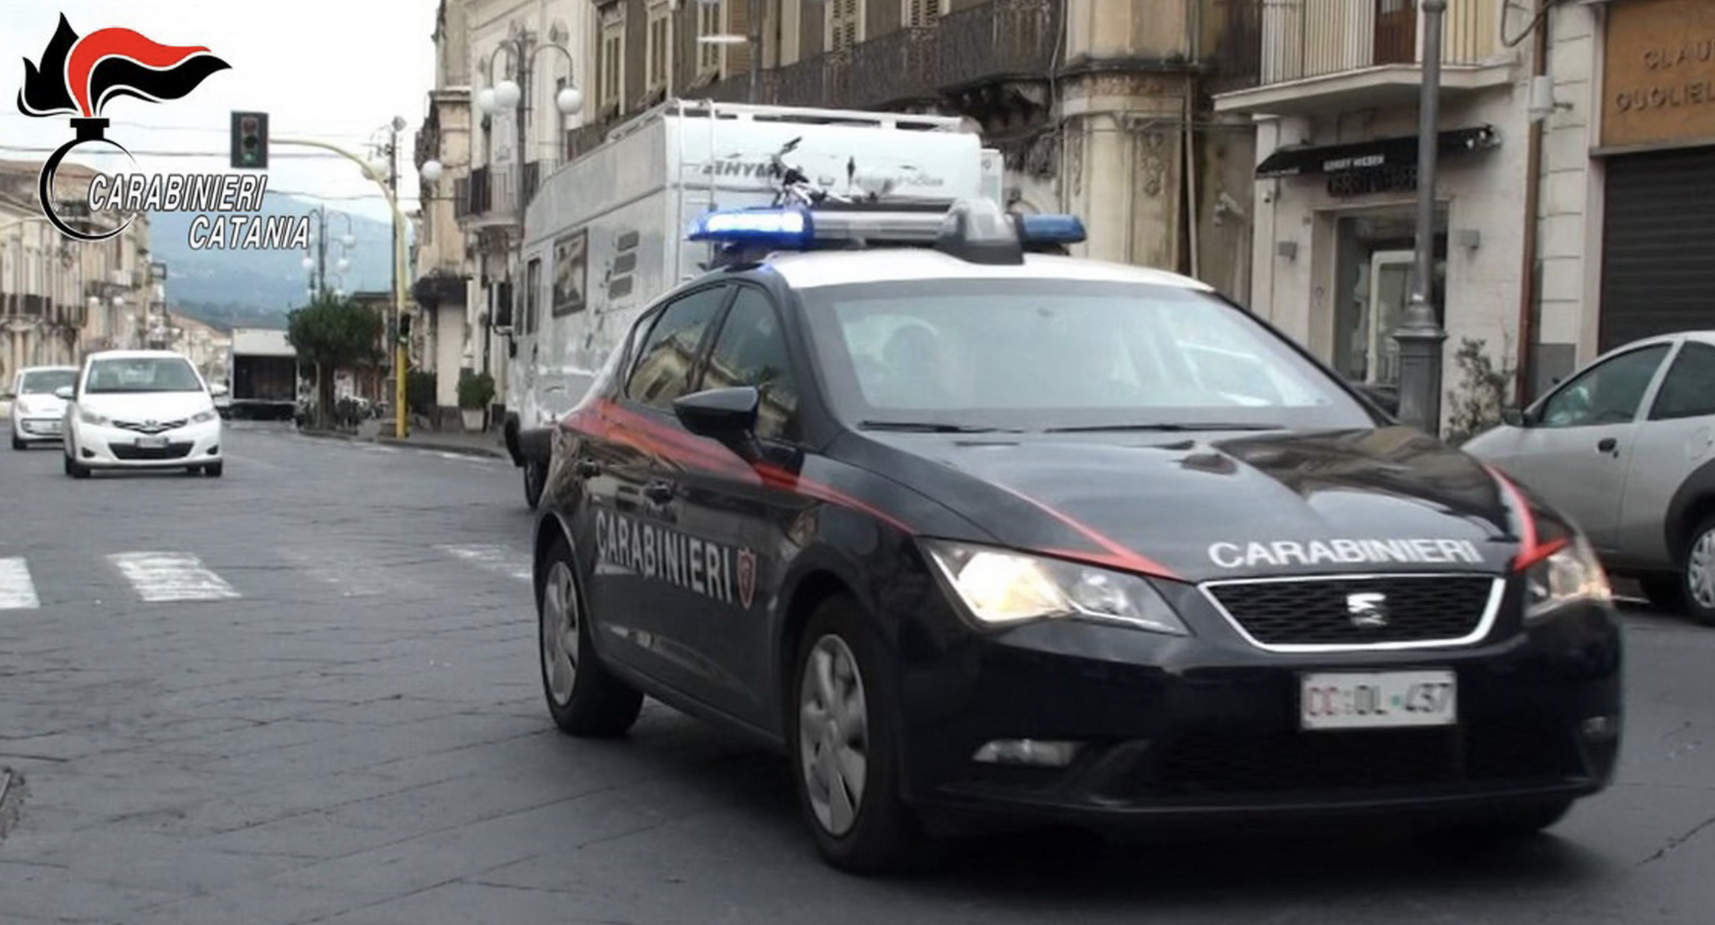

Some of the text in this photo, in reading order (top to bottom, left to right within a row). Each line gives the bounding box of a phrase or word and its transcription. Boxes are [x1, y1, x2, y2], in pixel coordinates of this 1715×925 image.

[1643, 40, 1715, 72] CLAU
[595, 509, 733, 604] CARABINIERI
[1208, 538, 1482, 568] CARABINIERI
